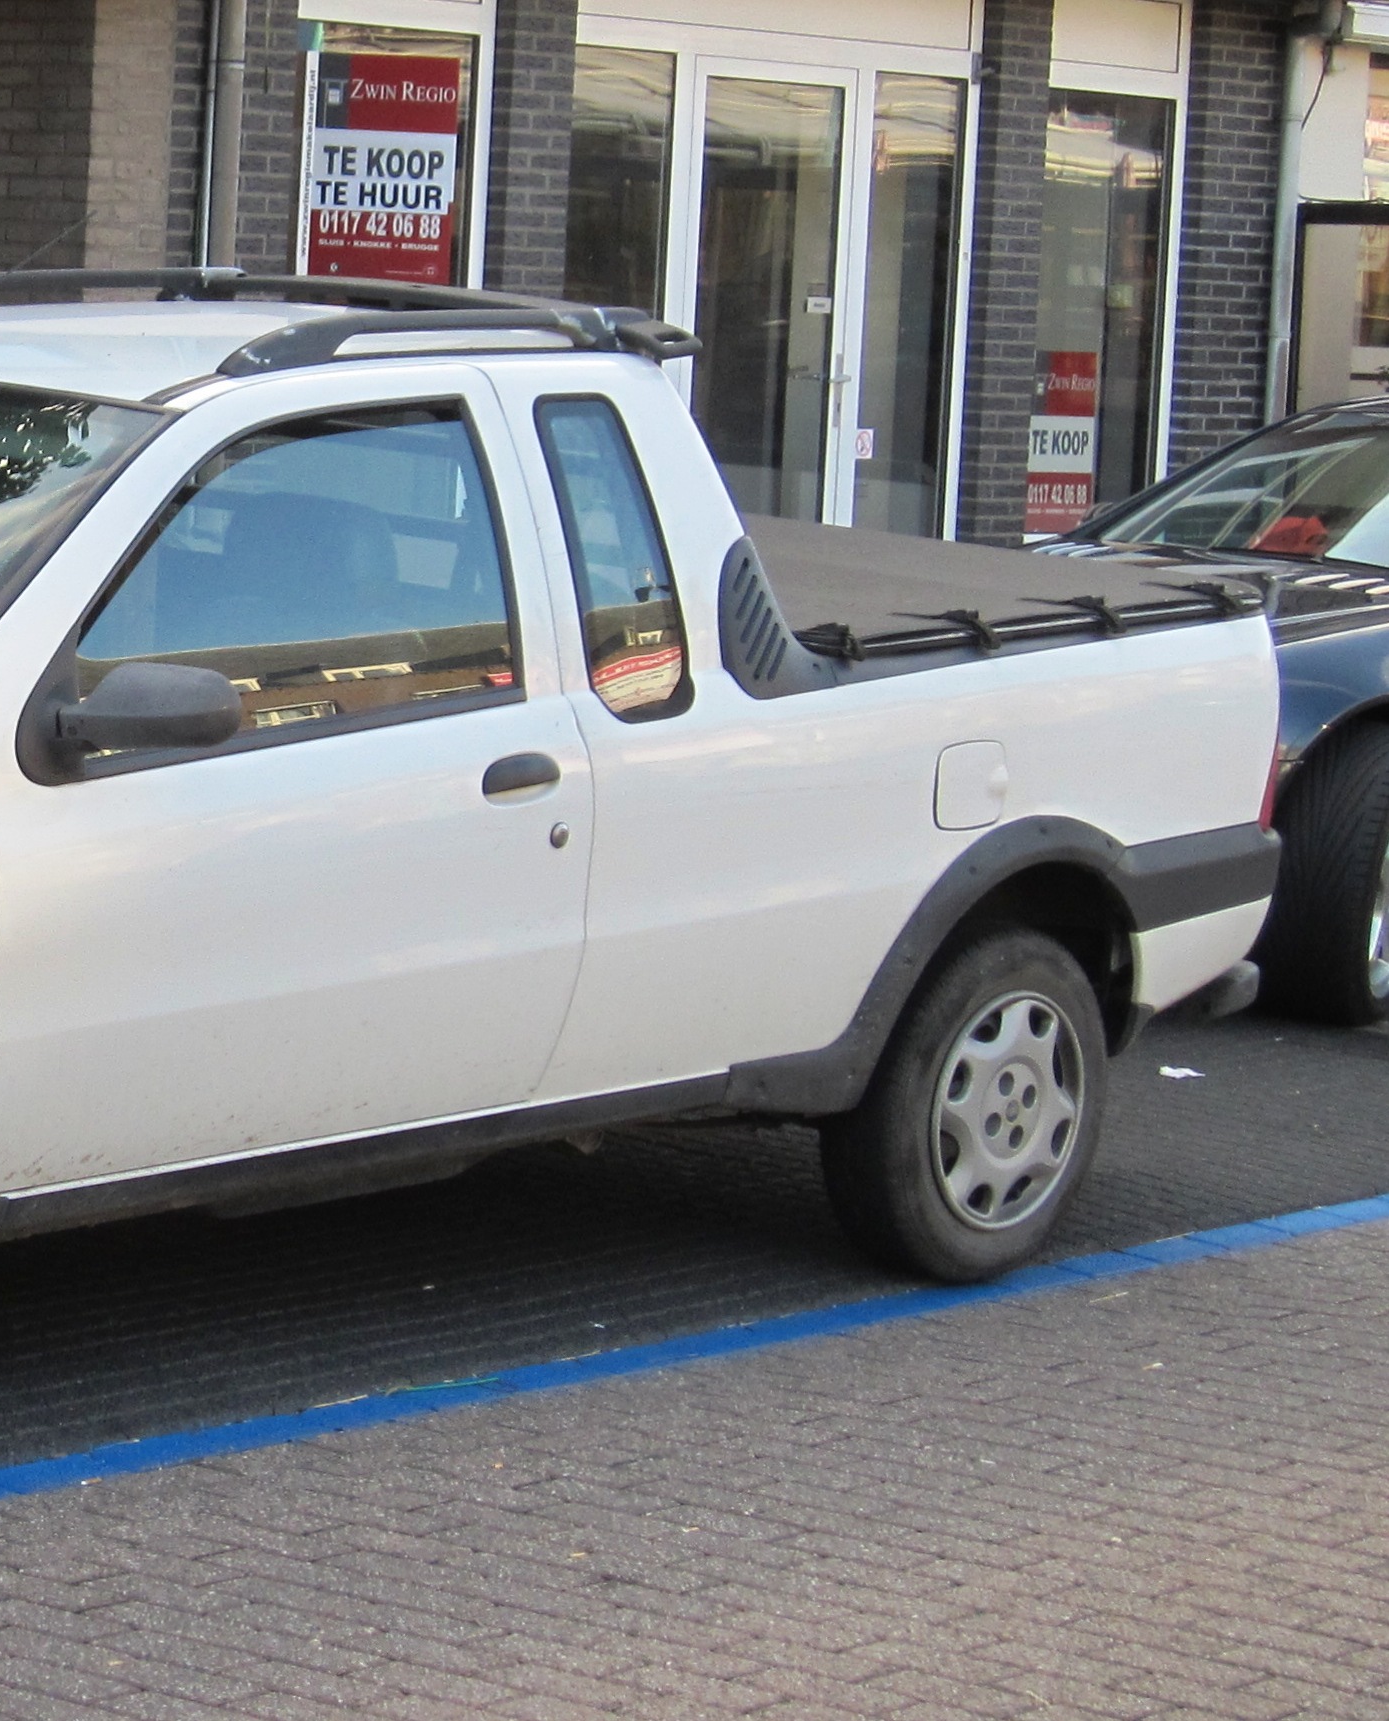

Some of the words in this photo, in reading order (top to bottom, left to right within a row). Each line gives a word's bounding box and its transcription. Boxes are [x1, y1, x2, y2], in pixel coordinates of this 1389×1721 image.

[323, 145, 357, 176] TE
[366, 147, 444, 180] KOOP
[316, 180, 348, 205] TE
[358, 181, 442, 210] HUUR
[319, 209, 361, 235] 0117
[366, 211, 387, 236] 42
[393, 213, 413, 238] 06
[419, 215, 440, 239] 88
[1032, 430, 1048, 455] TE
[1051, 430, 1089, 456] KOOP
[1027, 484, 1048, 503] 0117
[1051, 484, 1062, 504] 42
